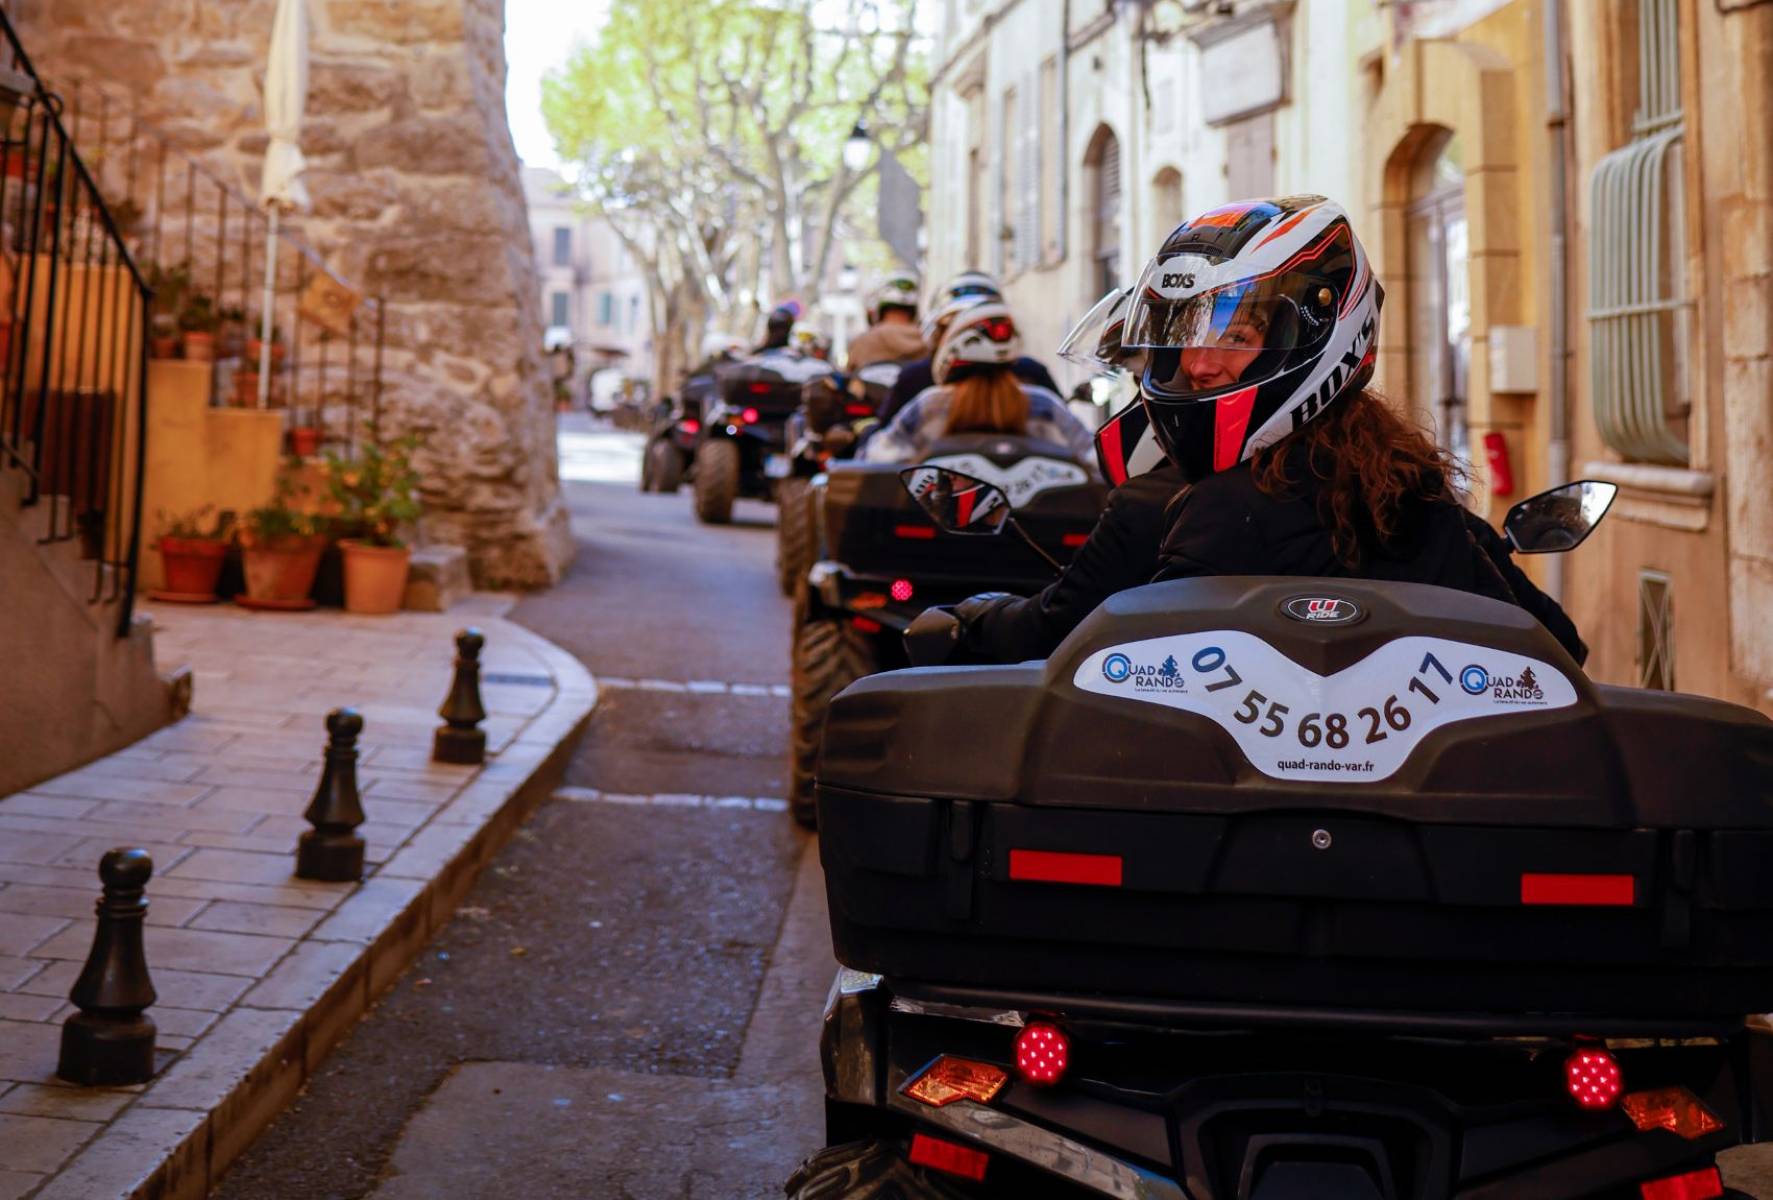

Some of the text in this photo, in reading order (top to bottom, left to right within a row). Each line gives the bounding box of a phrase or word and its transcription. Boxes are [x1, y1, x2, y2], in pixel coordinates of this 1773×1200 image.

[1306, 611, 1340, 620] RIDE
[1103, 653, 1156, 684] QUAD
[1135, 676, 1185, 688] RANDO
[1460, 664, 1514, 695] QUAD
[1192, 646, 1454, 749] 07 55 68 26 17
[1494, 688, 1544, 700] RANDO
[1277, 758, 1375, 772] quad-rando-var.fr
